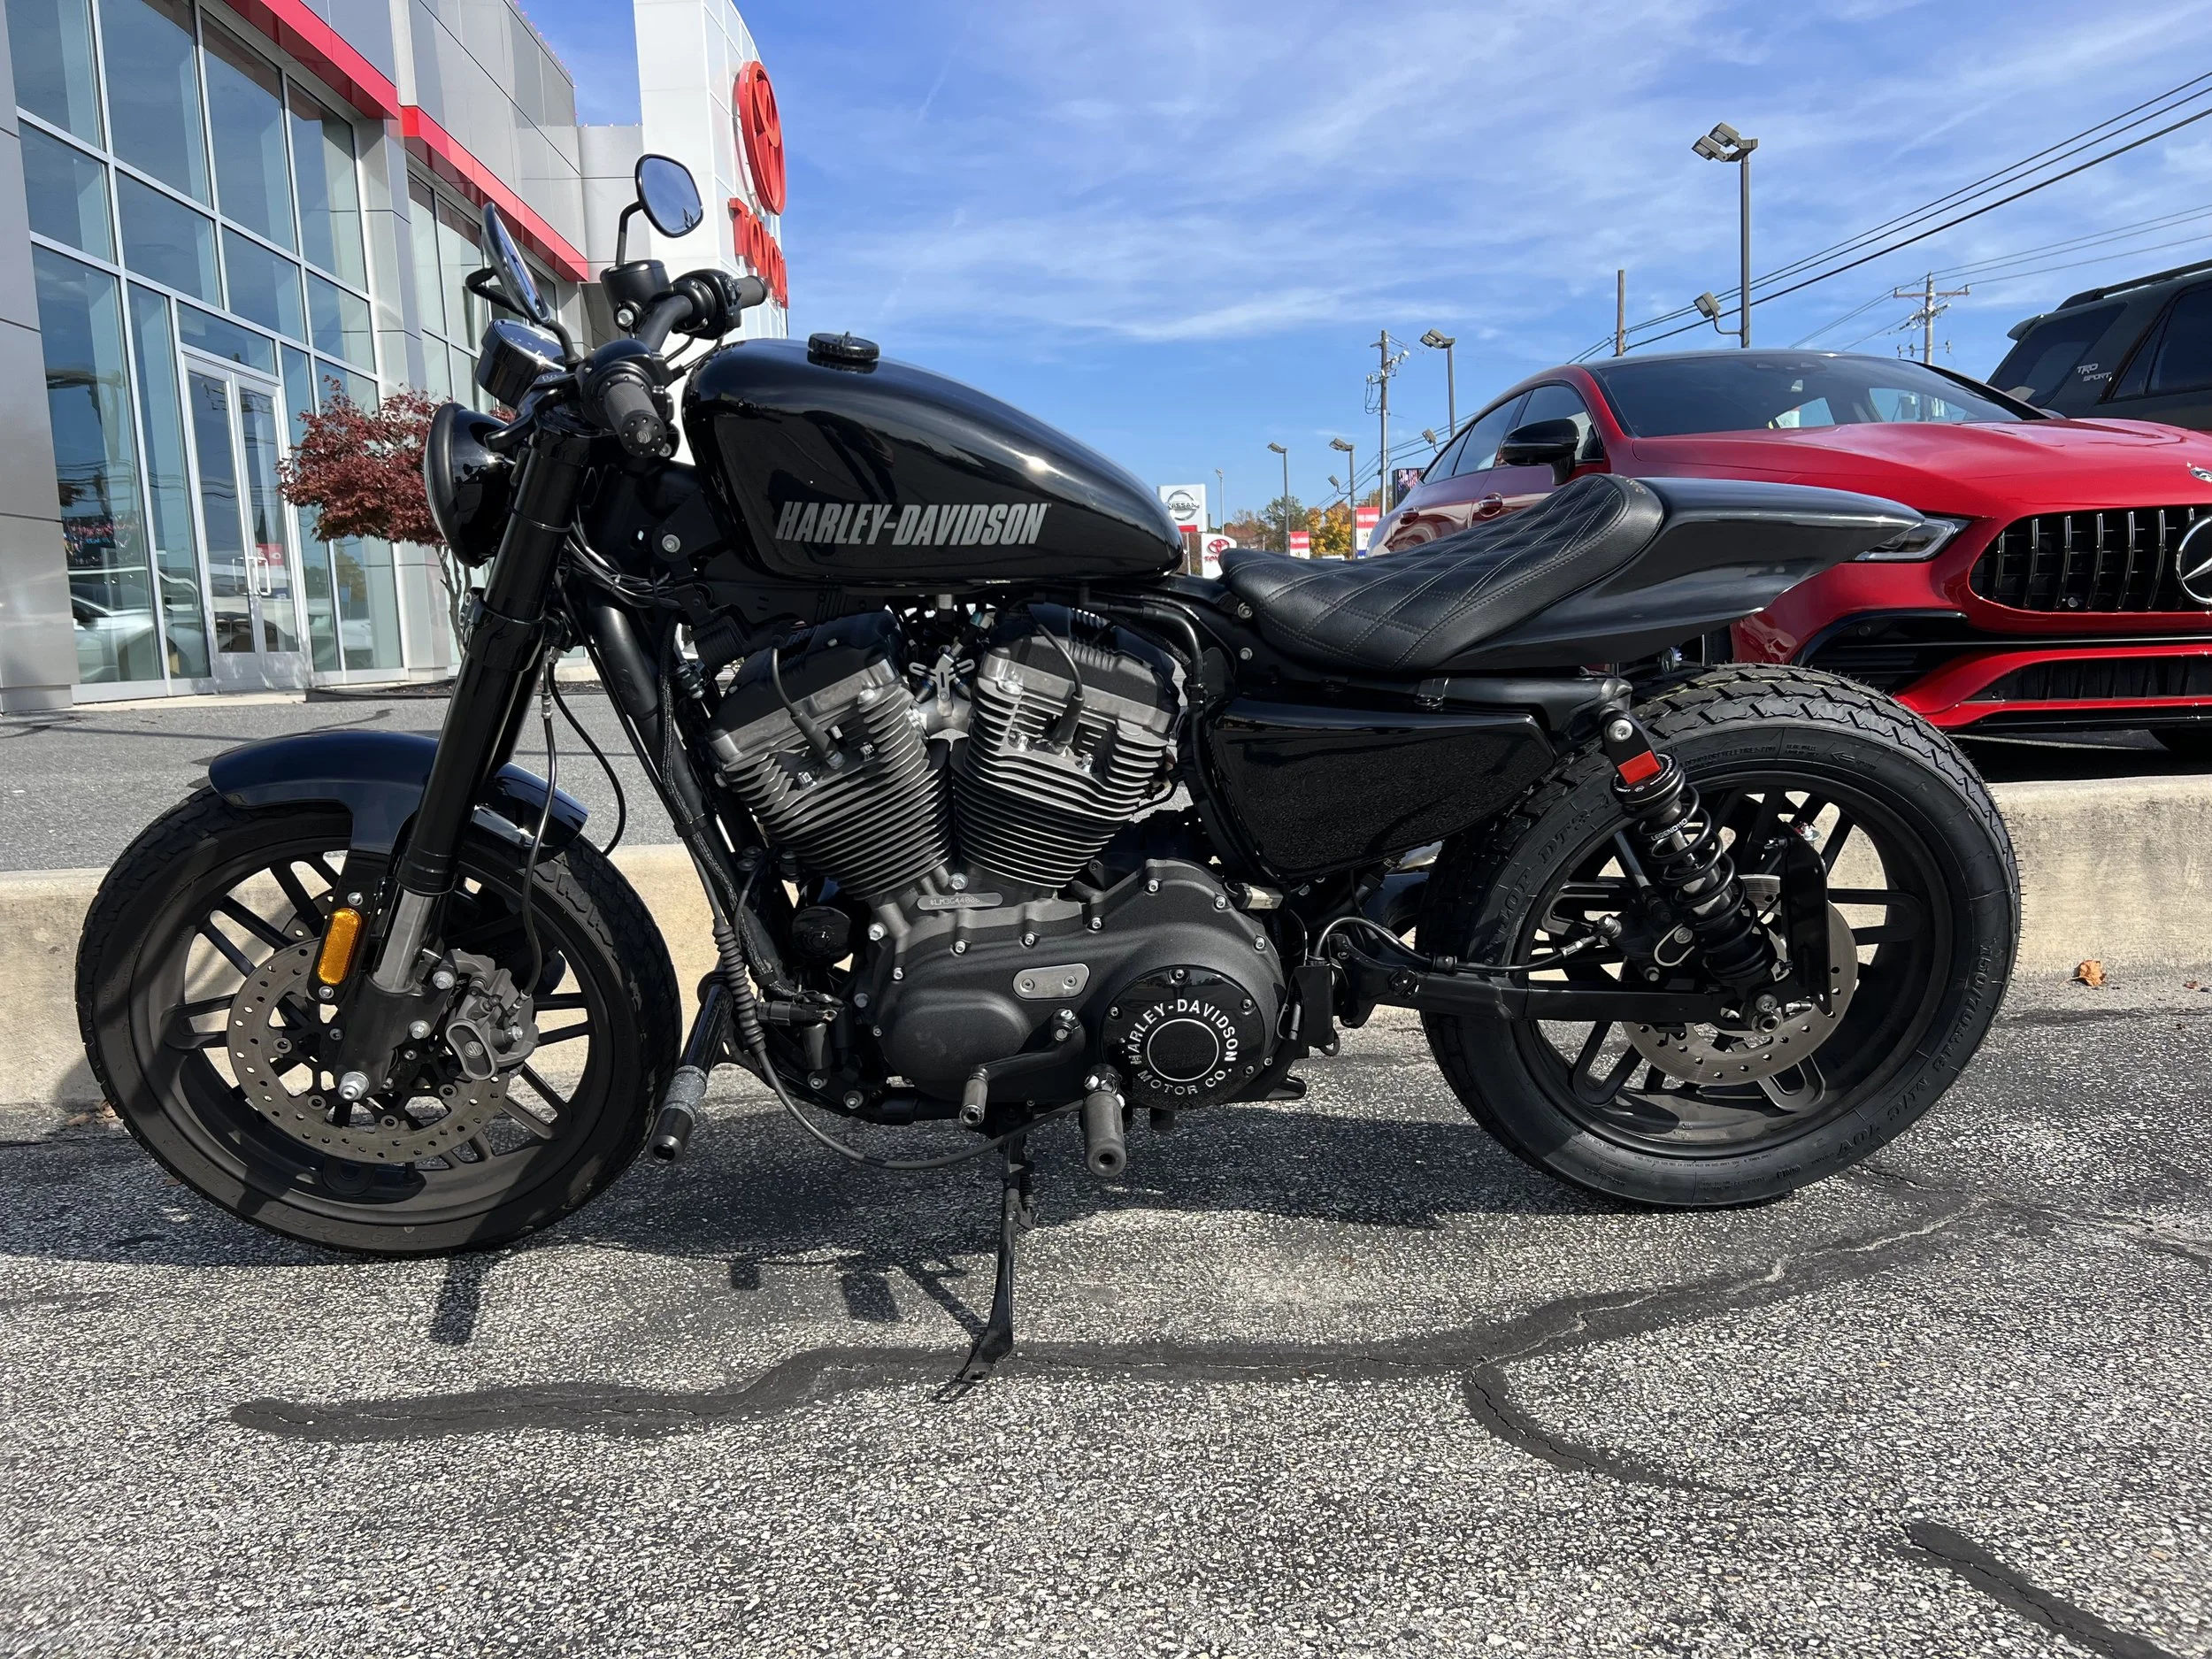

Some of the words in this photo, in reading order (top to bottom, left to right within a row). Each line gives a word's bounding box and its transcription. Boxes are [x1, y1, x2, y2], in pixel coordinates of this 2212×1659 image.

[727, 197, 788, 309] TOYOT
[2077, 363, 2099, 374] TRD
[2083, 372, 2112, 381] SPORT
[775, 501, 1048, 546] HARLEY-DAVIDSON
[1127, 998, 1239, 1064] HARLEY-DAVIDSON
[1137, 1070, 1198, 1095] MOTOR
[1205, 1068, 1233, 1087] CO.
